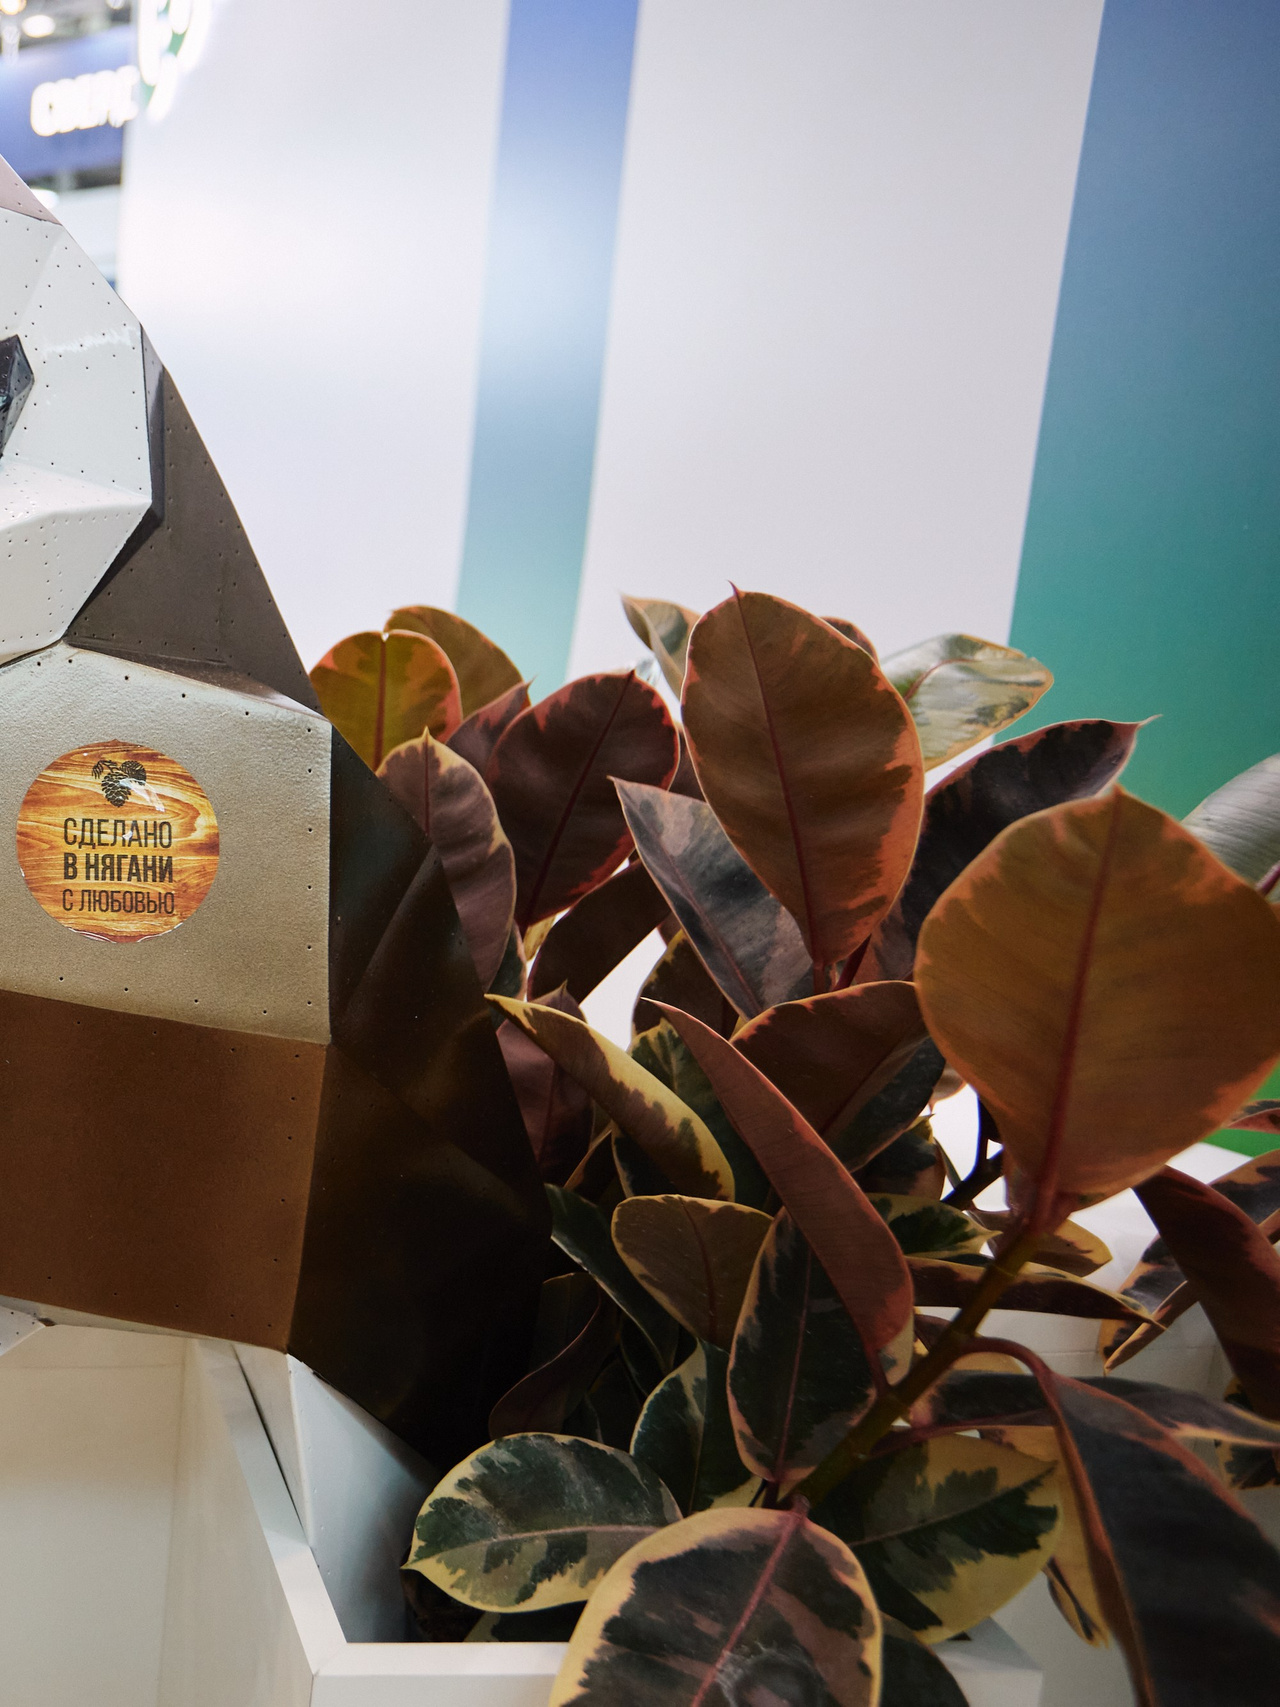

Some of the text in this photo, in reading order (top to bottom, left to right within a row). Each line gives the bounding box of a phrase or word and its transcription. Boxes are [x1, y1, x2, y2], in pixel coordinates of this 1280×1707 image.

[63, 817, 173, 849] СДЕЛАНО
[63, 852, 173, 883] В НЯГАНИ
[62, 888, 175, 914] С ЛЮБОВЬЮ
